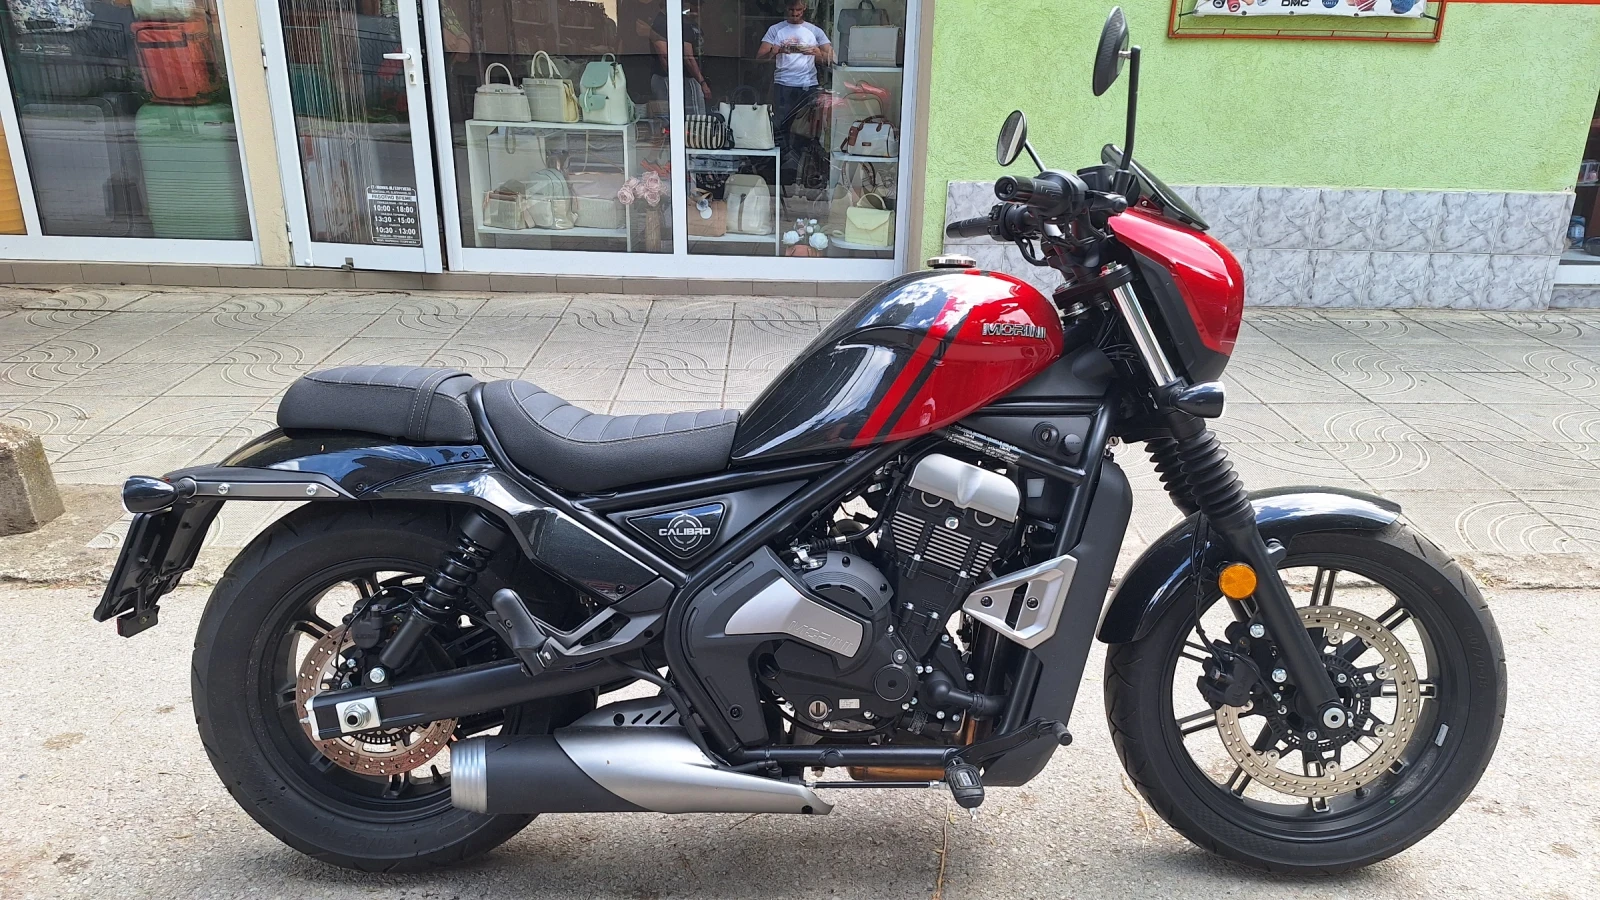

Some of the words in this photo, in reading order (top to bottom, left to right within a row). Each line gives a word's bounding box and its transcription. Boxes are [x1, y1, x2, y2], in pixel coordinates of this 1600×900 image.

[376, 226, 393, 234] 10:30
[982, 322, 1046, 339] MORINI
[658, 527, 711, 536] CALIBRO
